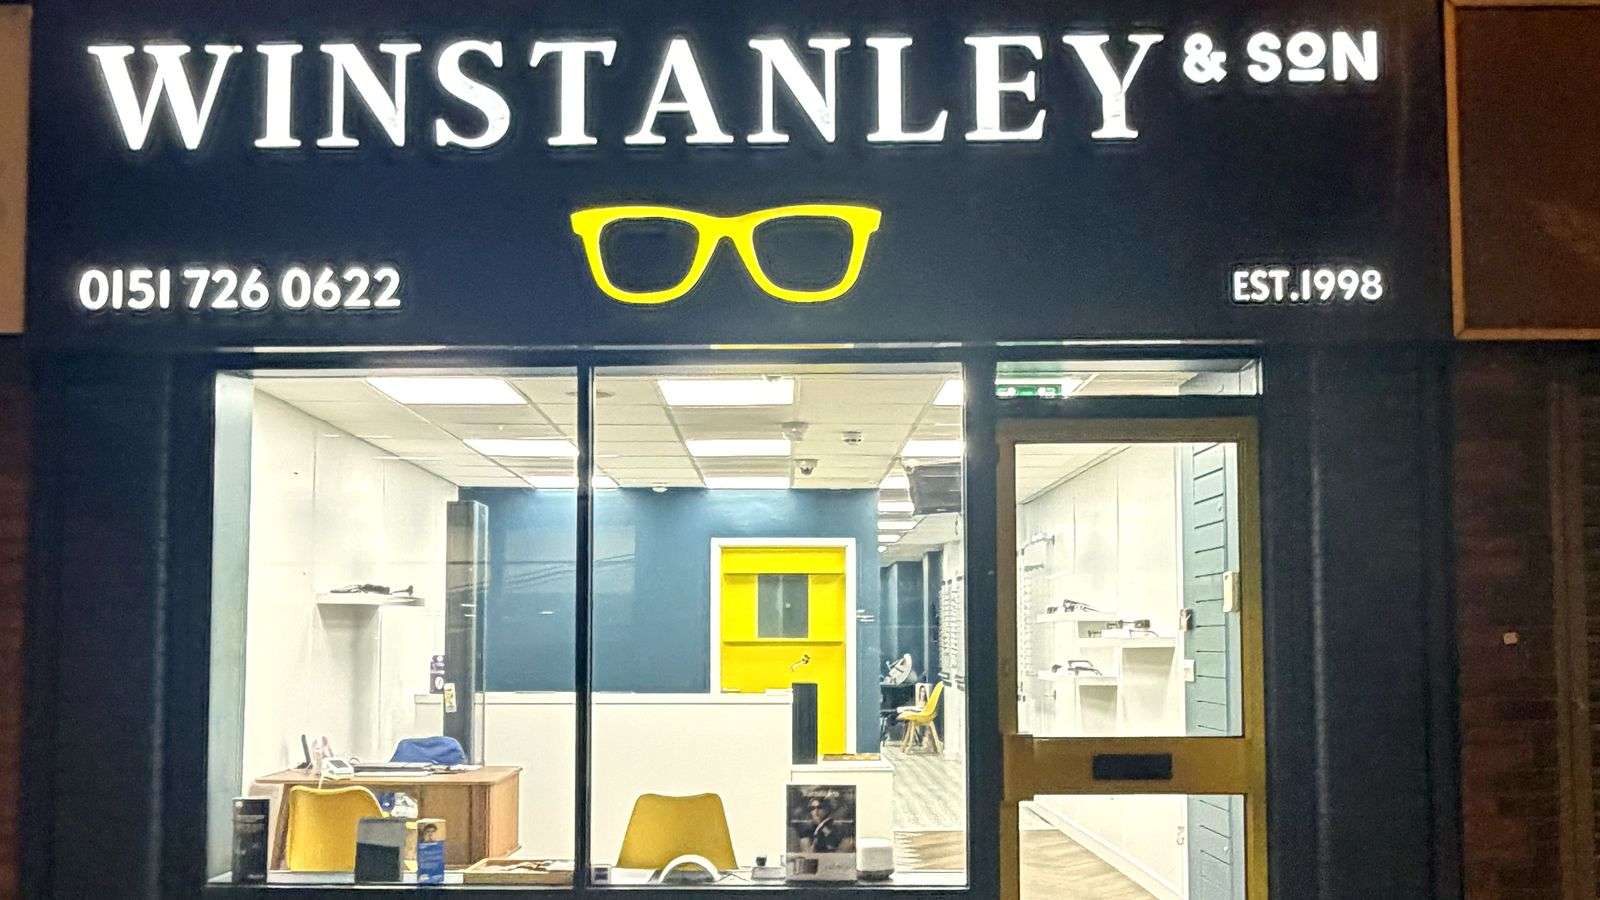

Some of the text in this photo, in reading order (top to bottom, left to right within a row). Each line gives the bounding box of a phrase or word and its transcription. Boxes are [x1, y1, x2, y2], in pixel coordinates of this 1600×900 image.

[87, 31, 1378, 151] WINSTANLEY & SON
[78, 267, 401, 310] 0151 726 0622
[1233, 268, 1383, 302] EST.1998
